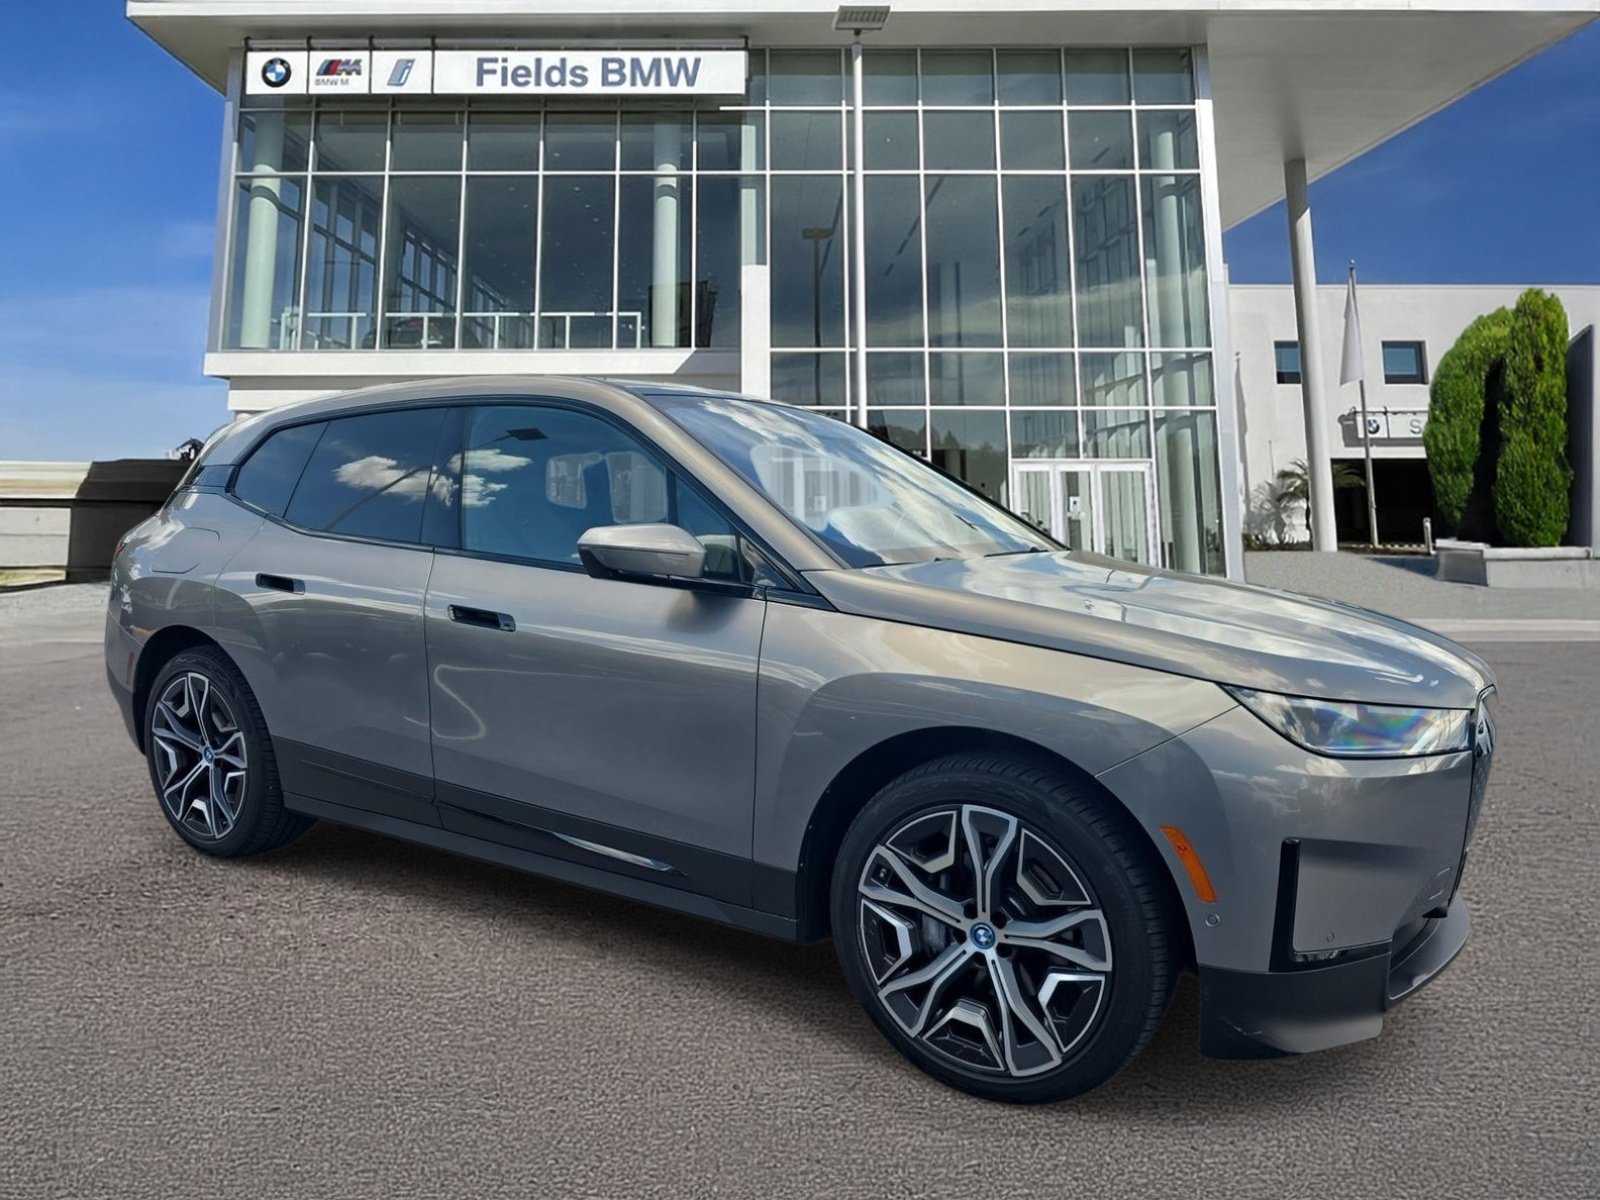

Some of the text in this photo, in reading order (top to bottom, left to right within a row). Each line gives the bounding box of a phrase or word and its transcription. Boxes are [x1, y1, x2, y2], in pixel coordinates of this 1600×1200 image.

[314, 77, 339, 86] BMW
[476, 56, 702, 88] Fields BMW
